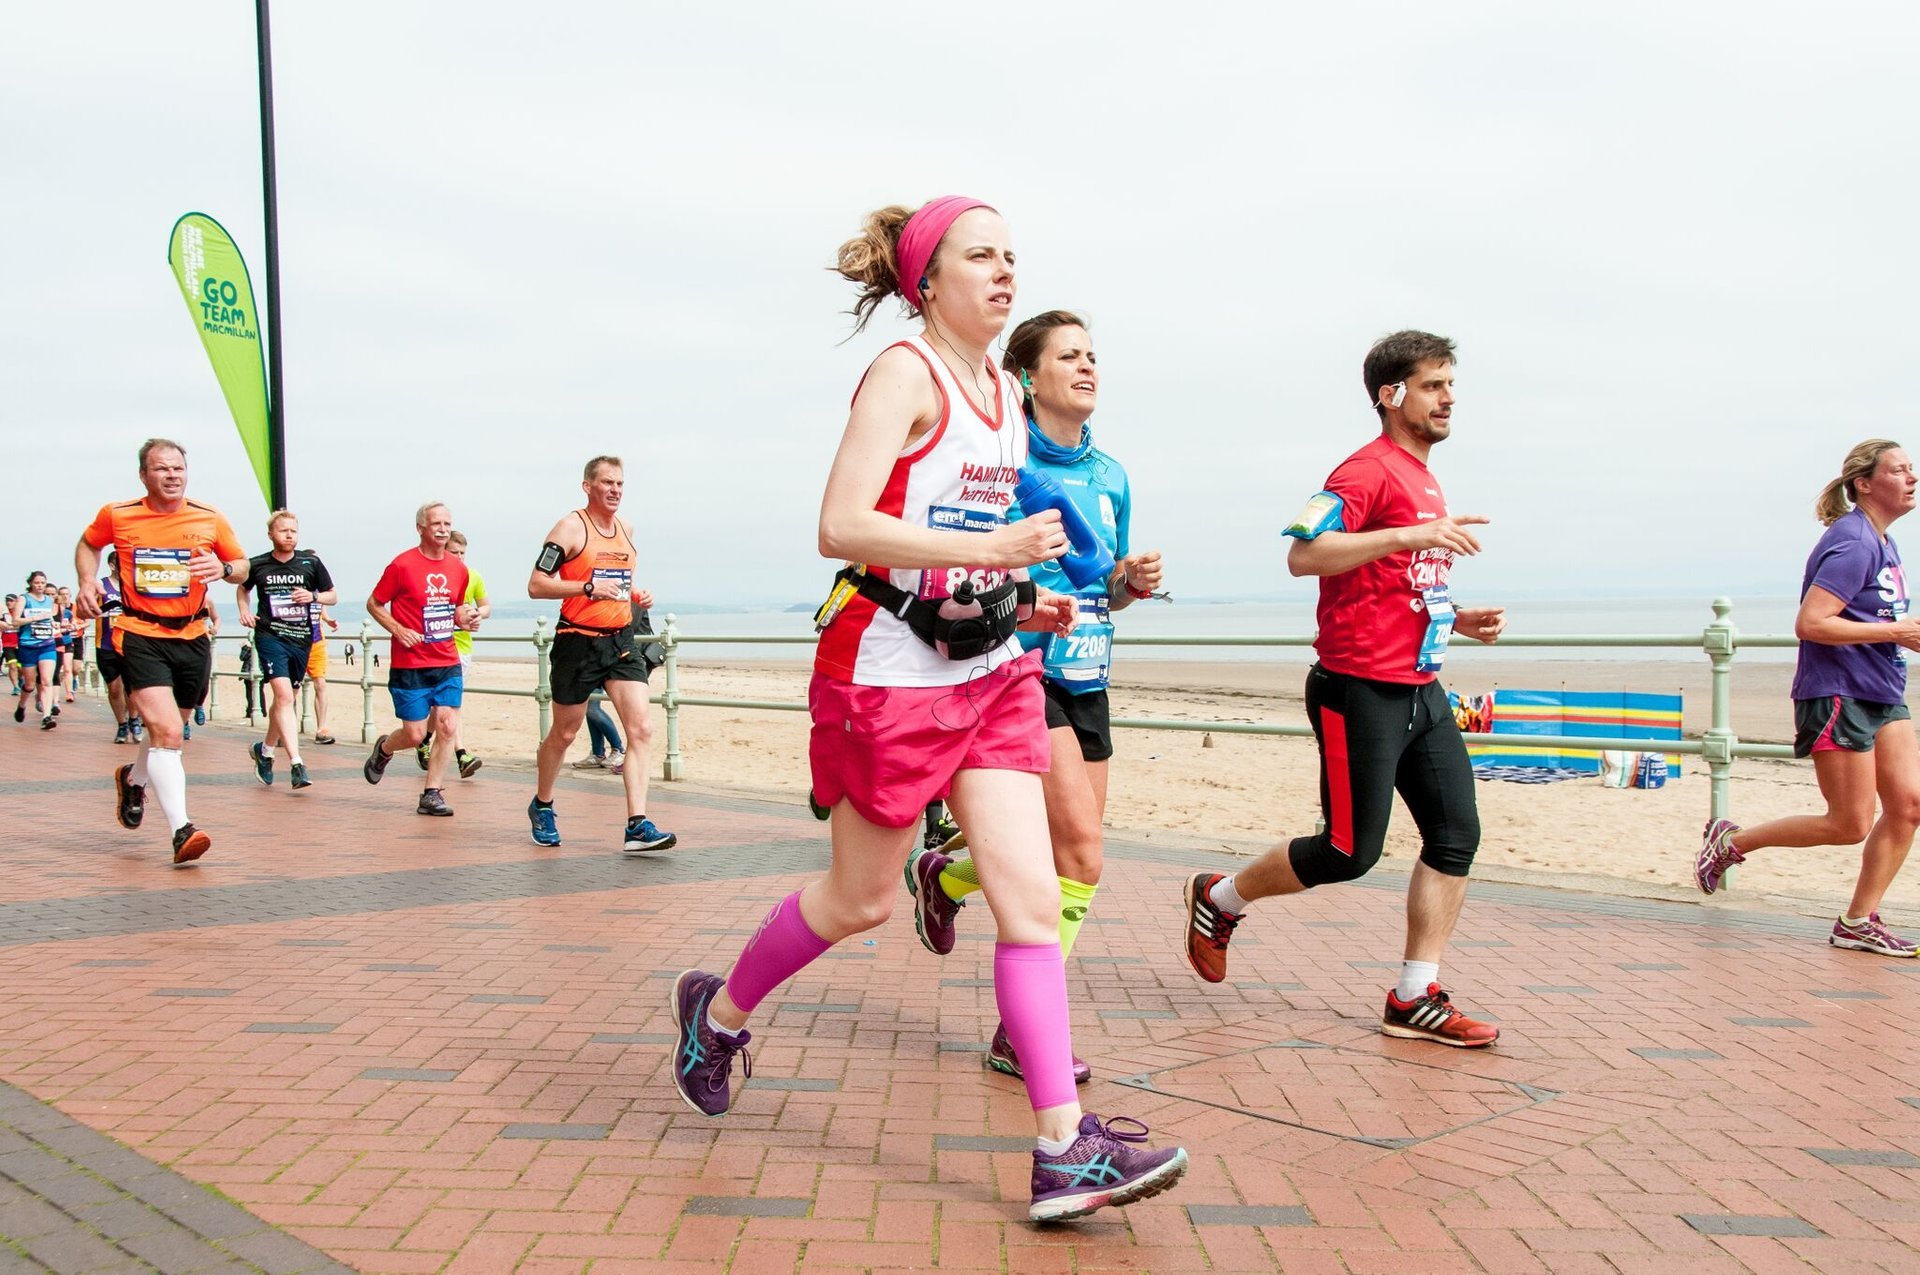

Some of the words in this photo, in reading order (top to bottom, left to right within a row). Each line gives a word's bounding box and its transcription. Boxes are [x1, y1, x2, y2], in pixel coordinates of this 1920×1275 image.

[203, 277, 238, 306] GO
[200, 301, 246, 327] TEAM
[203, 321, 256, 340] MACMILLAN
[266, 574, 304, 585] SIMON
[1065, 634, 1107, 658] 7208
